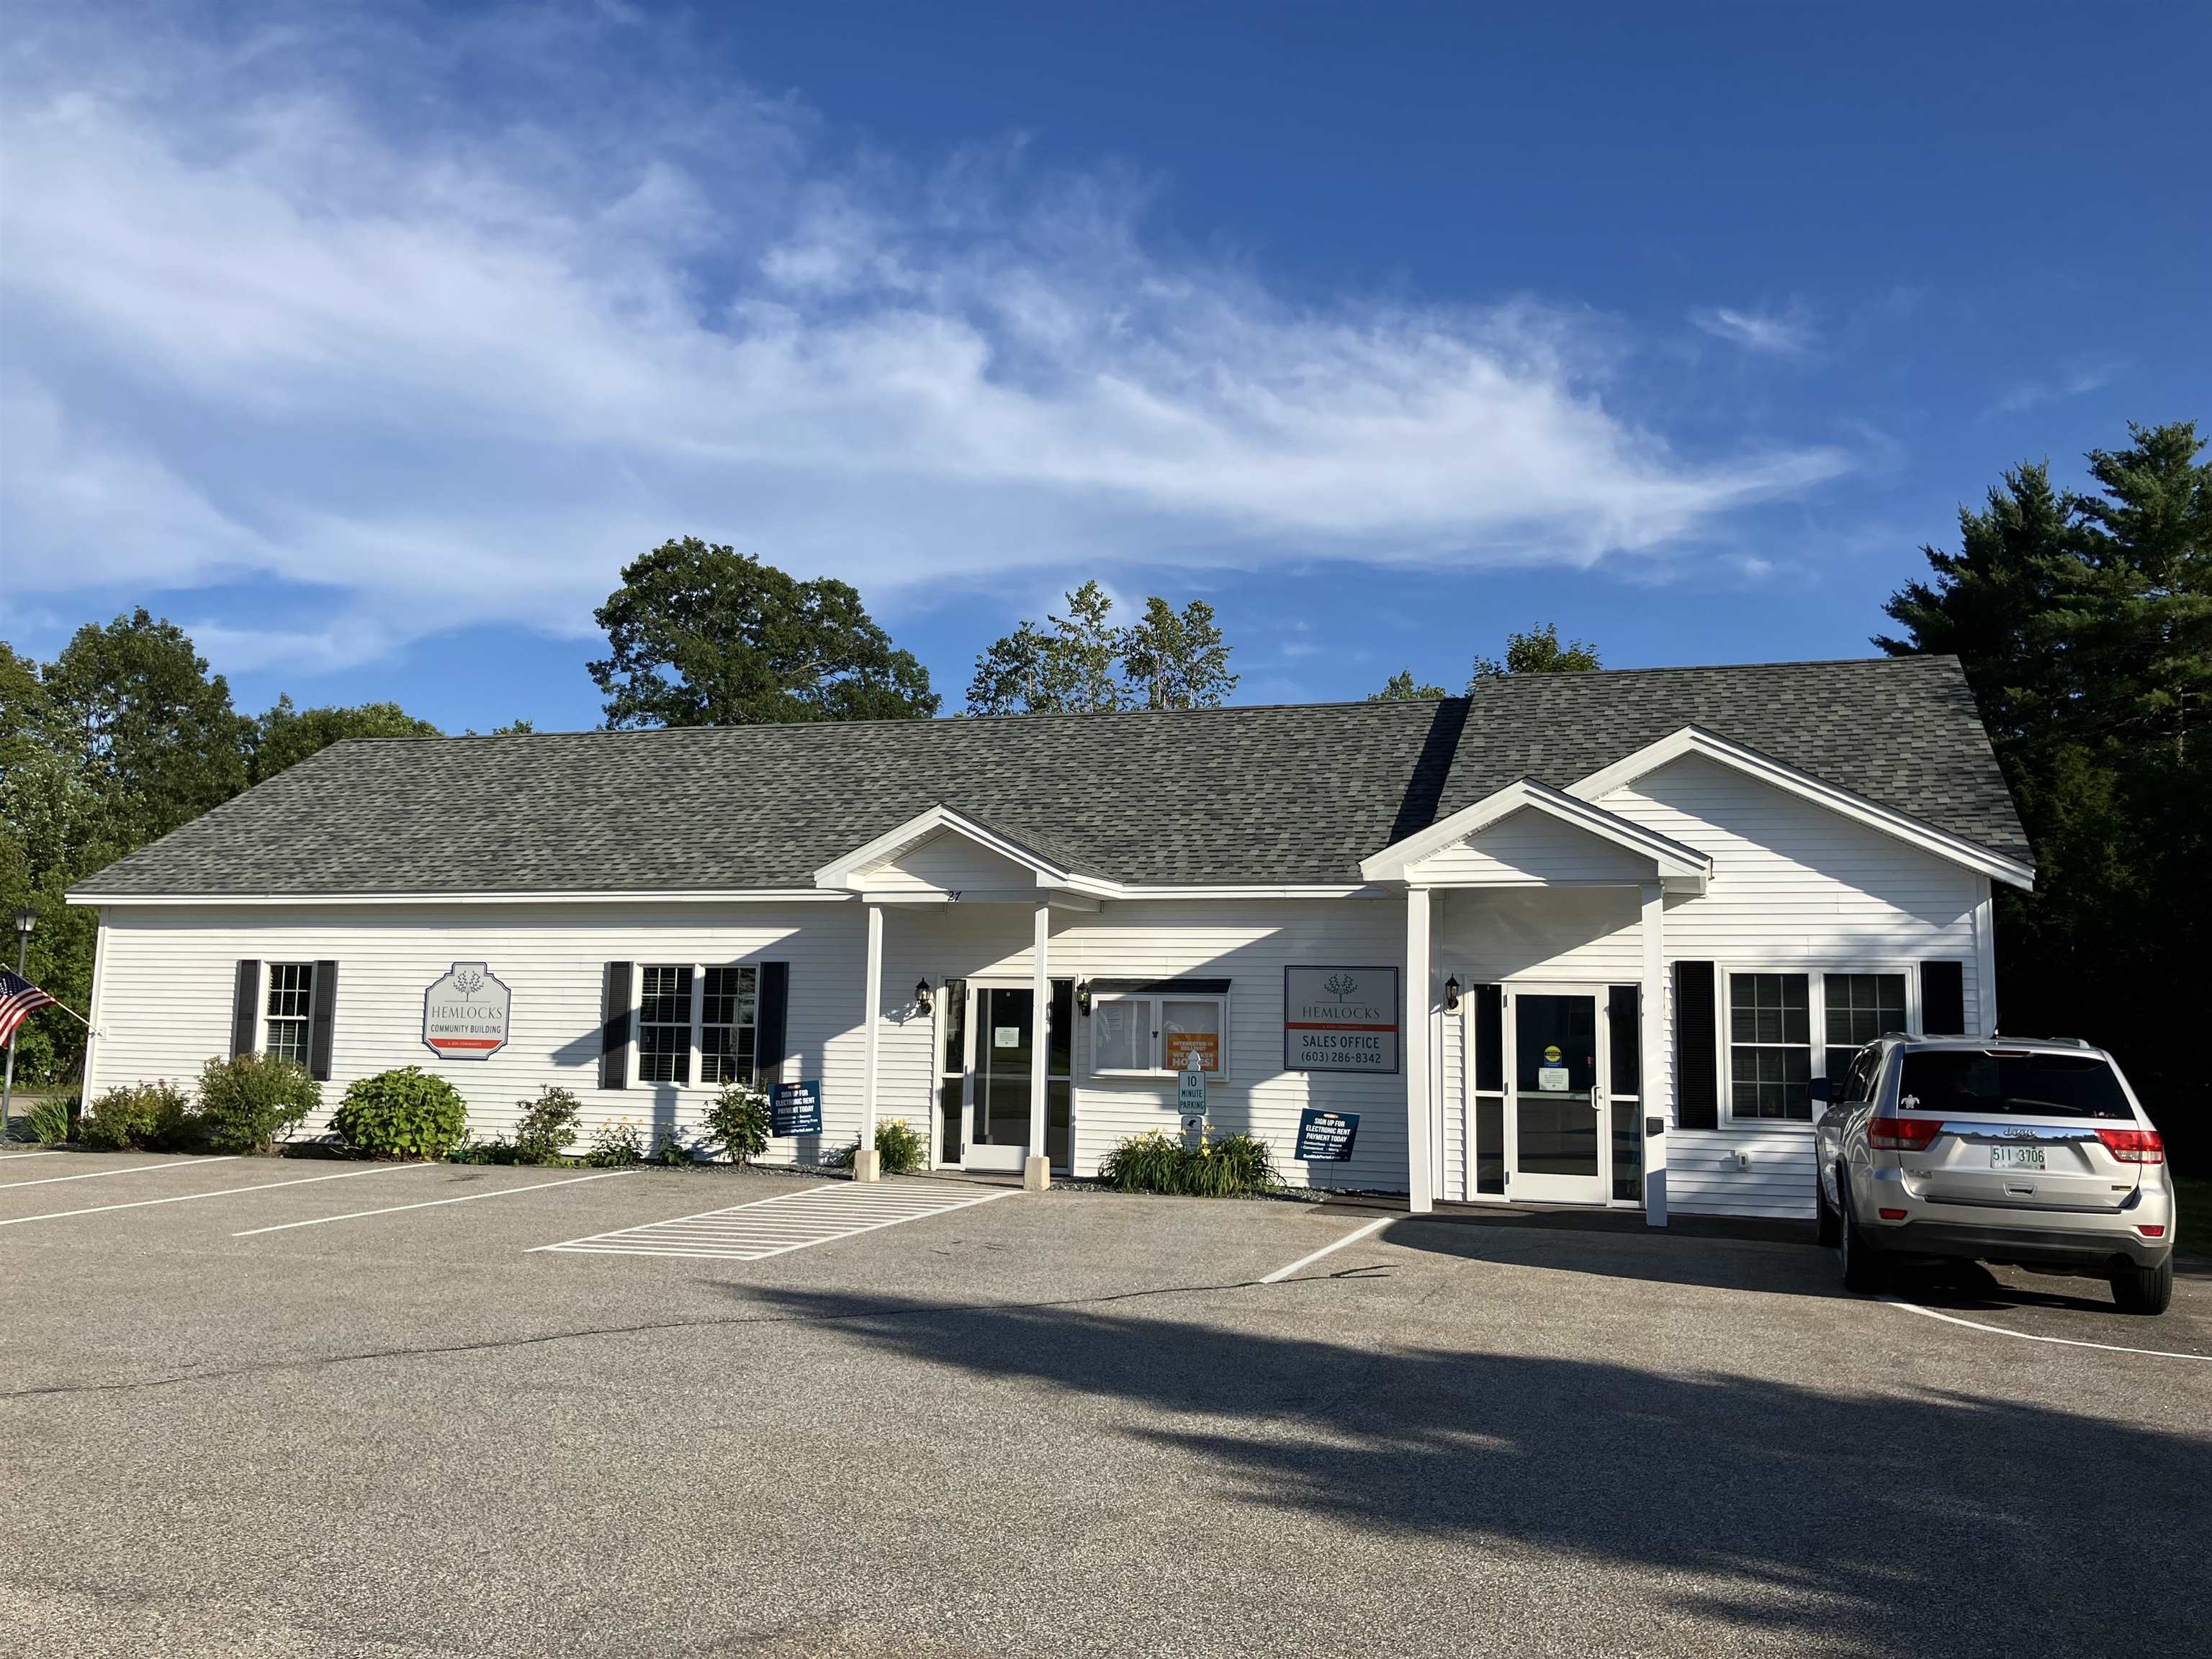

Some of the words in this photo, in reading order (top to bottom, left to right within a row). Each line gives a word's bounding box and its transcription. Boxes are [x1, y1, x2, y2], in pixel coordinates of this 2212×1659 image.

[431, 1006, 503, 1020] HEMLOCKS
[1302, 1006, 1380, 1020] HEMLOCKS
[431, 1024, 469, 1033] COMMUNITY
[470, 1025, 501, 1034] BUILDING
[1303, 1035, 1336, 1048] SALES
[1340, 1036, 1380, 1049] OFFICE
[1301, 1051, 1328, 1063] (603)
[1331, 1052, 1381, 1064] 286-8342
[1187, 1076, 1197, 1087] 10
[1182, 1089, 1202, 1098] MINUTE
[775, 1098, 803, 1107] ELECTRONIC
[1180, 1100, 1204, 1110] PARKING
[778, 1106, 799, 1115] PAYMENT
[799, 1105, 814, 1113] TODAY
[1305, 1124, 1336, 1134] ELECTRONIC
[1305, 1132, 1330, 1141] PAYMENT
[1993, 1148, 2011, 1161] 511
[2018, 1149, 2045, 1163] 3706
